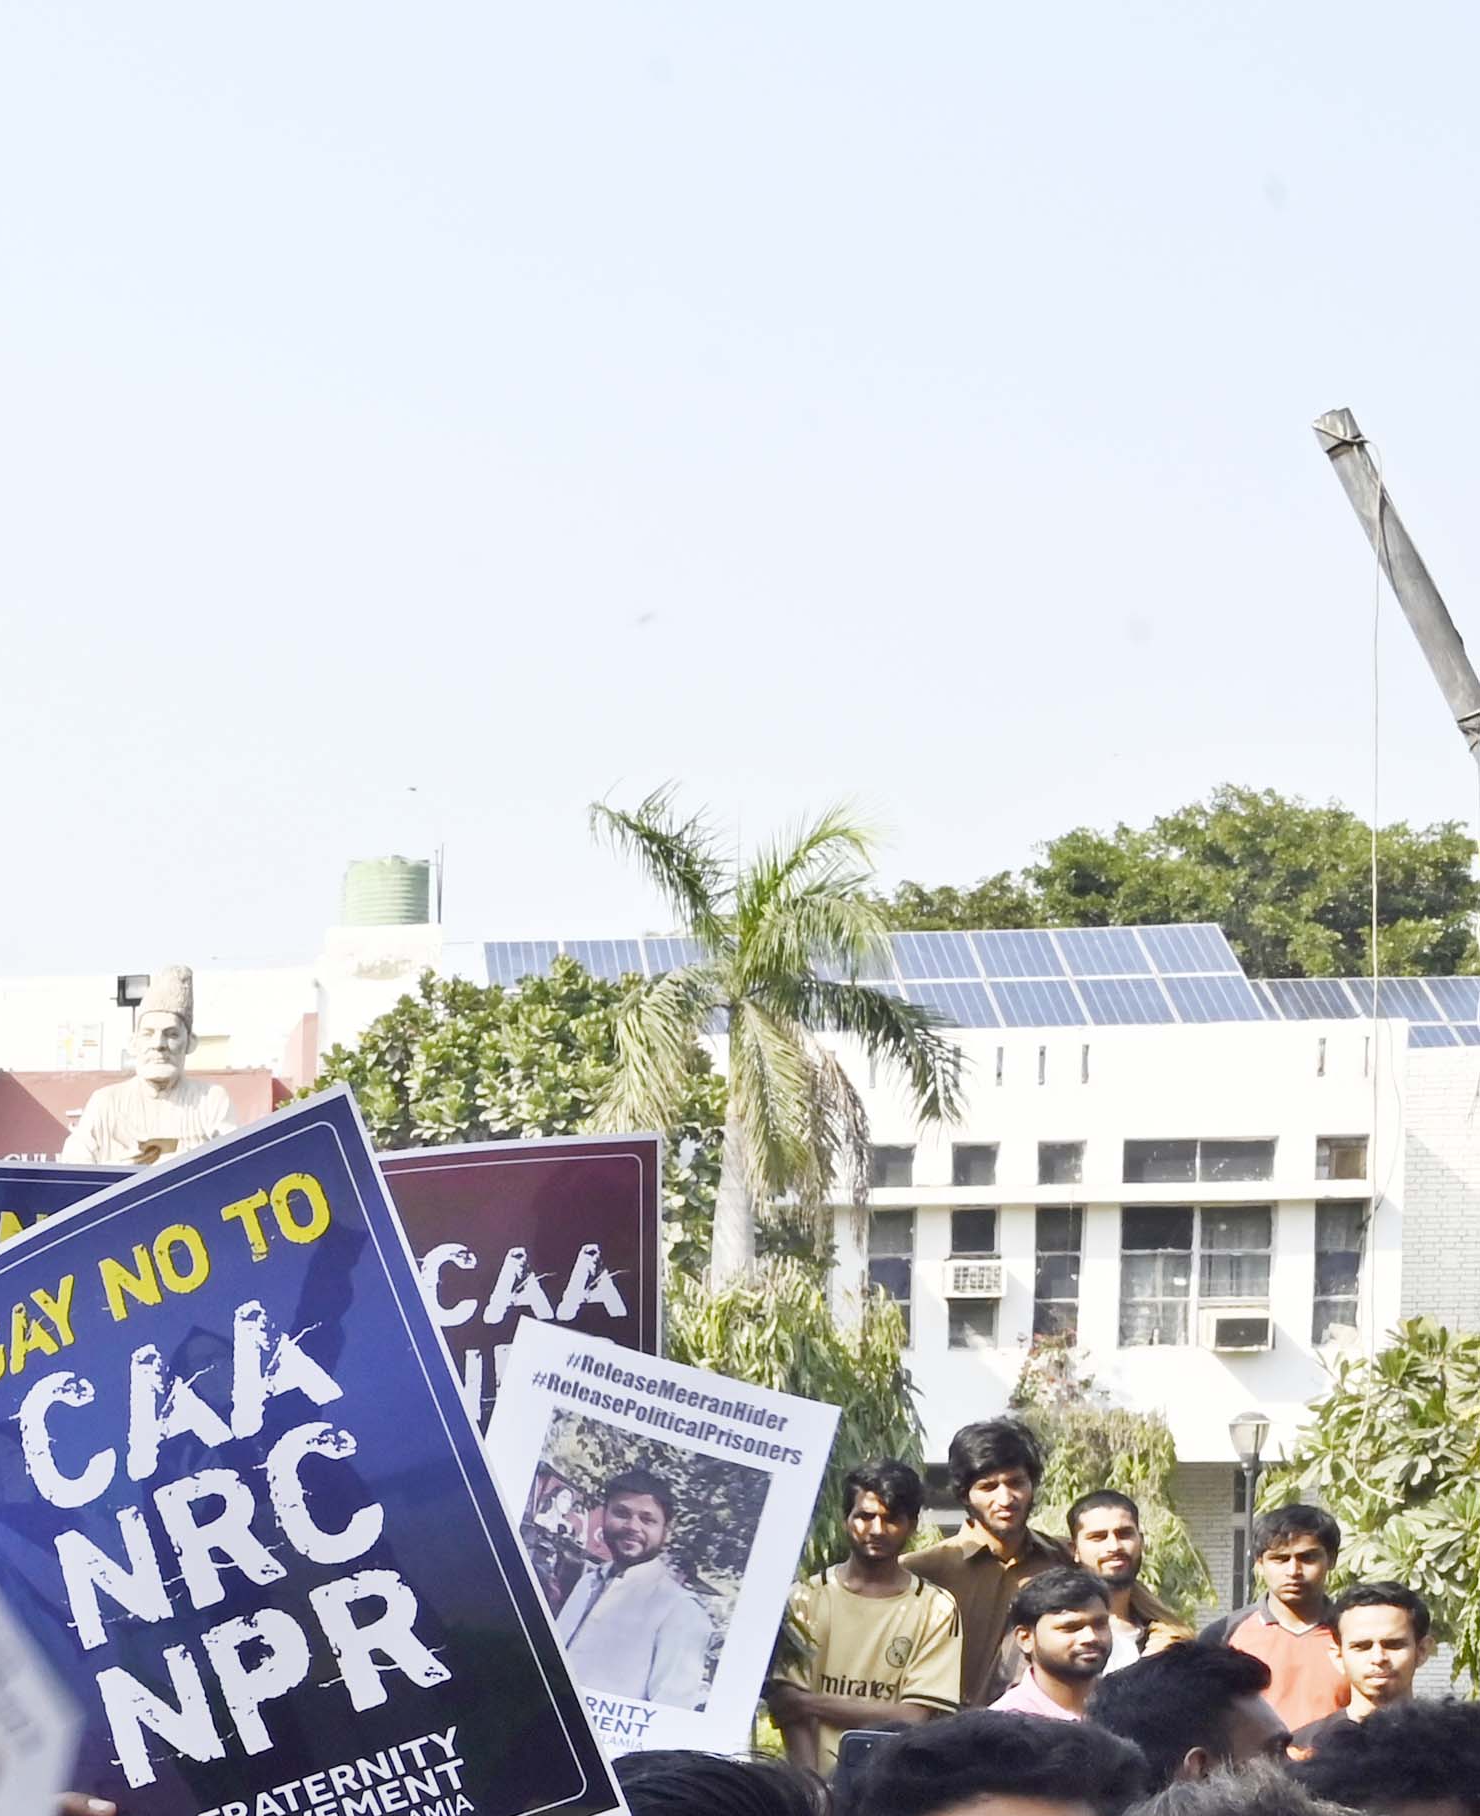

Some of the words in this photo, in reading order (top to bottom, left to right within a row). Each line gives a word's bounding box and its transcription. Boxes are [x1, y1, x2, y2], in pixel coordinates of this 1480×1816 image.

[98, 1224, 210, 1321] NO
[221, 1172, 330, 1263] TO
[417, 1243, 629, 1327] CAA
[15, 1300, 344, 1508] CAA
[532, 1371, 802, 1465] #ReleasePoliticalPrisoners
[566, 1352, 788, 1432] #ReleaseMeeranHider
[54, 1422, 384, 1650] NRC
[96, 1569, 452, 1789] NPR
